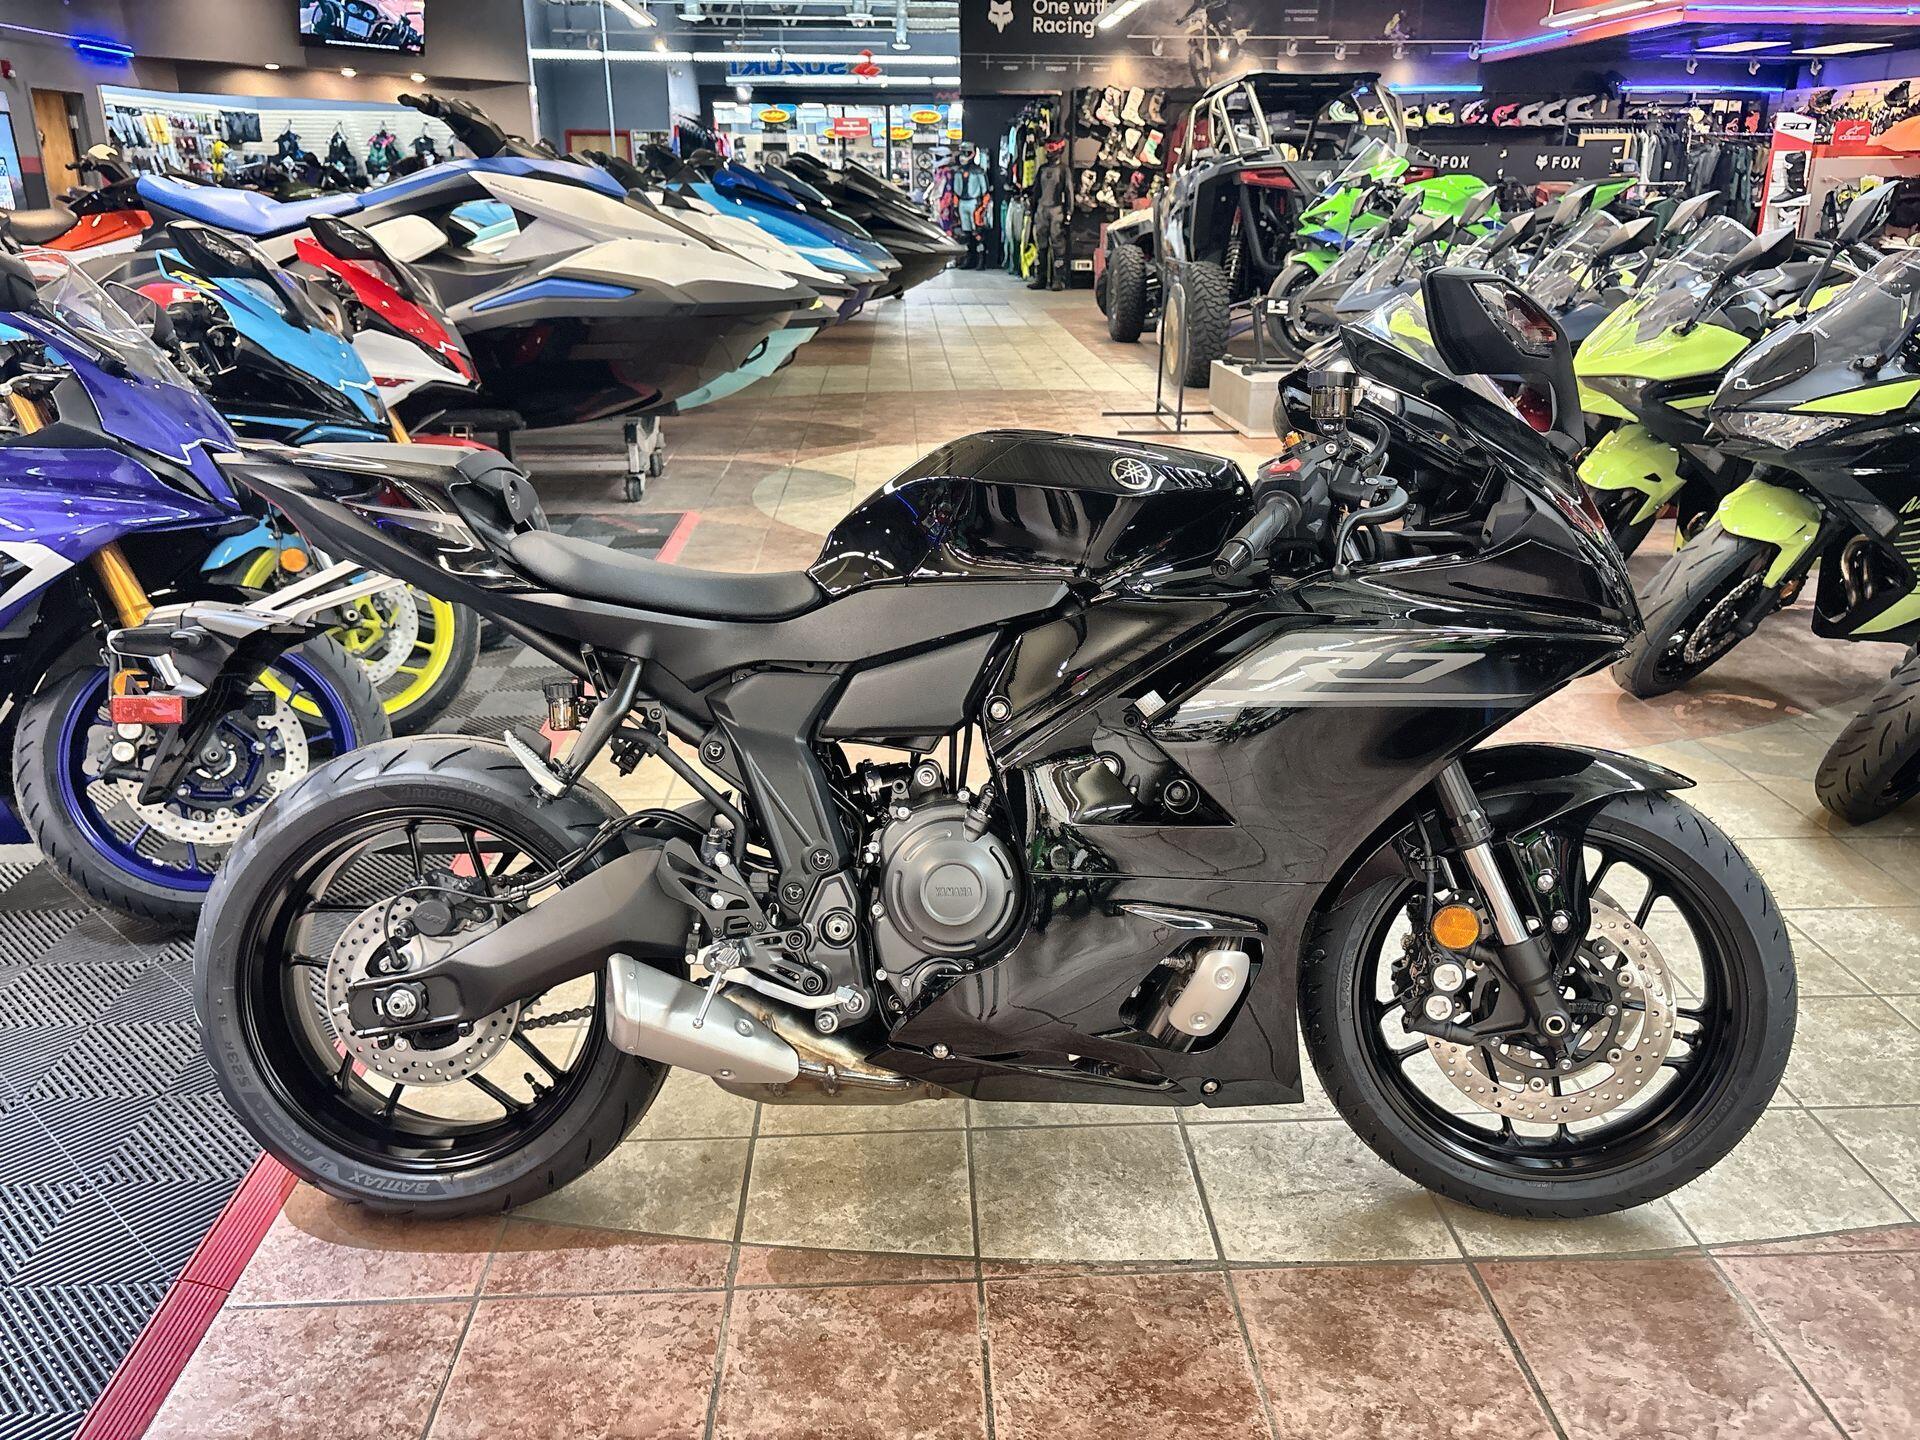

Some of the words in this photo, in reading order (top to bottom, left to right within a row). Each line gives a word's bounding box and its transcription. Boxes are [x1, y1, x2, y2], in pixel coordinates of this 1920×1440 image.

[1033, 0, 1070, 14] One
[1033, 16, 1095, 39] Racing
[1440, 155, 1470, 169] FOX
[1551, 155, 1581, 169] FOX
[1248, 651, 1487, 685] R7
[935, 886, 973, 897] YAMAHA
[348, 1173, 432, 1195] BATTLAX
